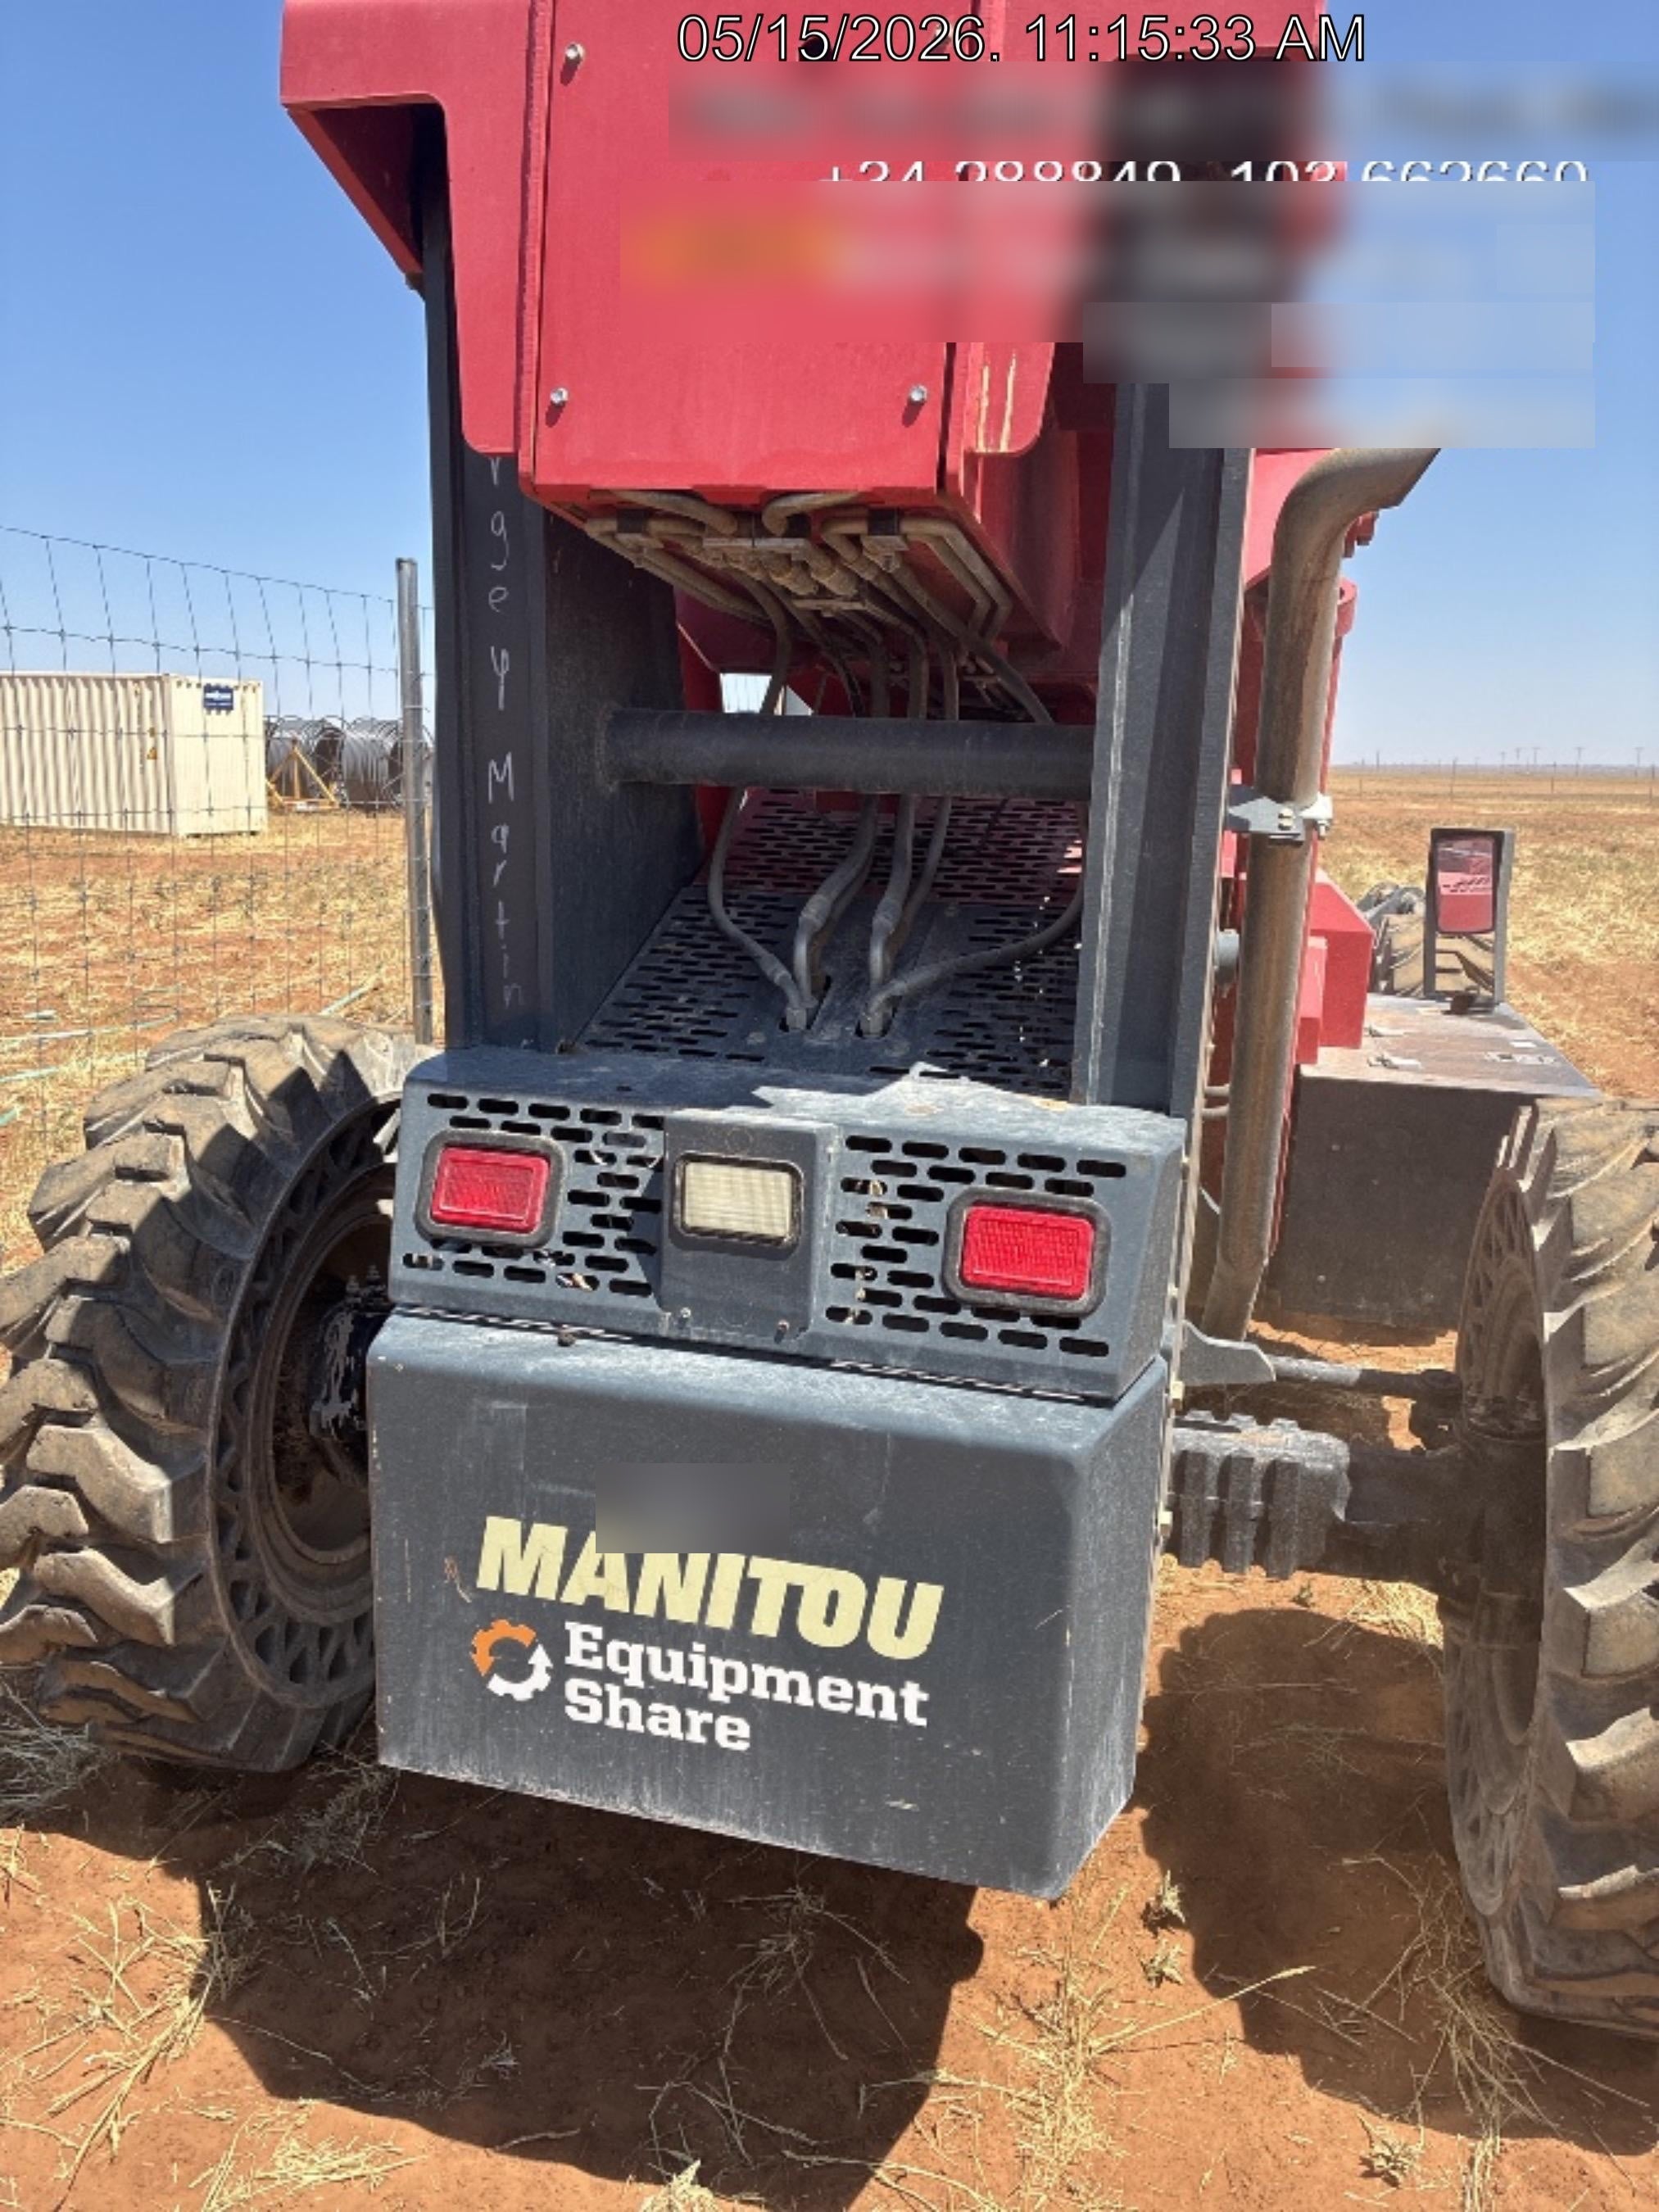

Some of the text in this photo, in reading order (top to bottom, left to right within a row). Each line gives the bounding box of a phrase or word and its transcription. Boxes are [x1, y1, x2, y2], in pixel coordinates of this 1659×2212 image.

[476, 1516, 945, 1660] MANITOU
[564, 1621, 930, 1727] Equipment
[564, 1678, 751, 1752] Share
